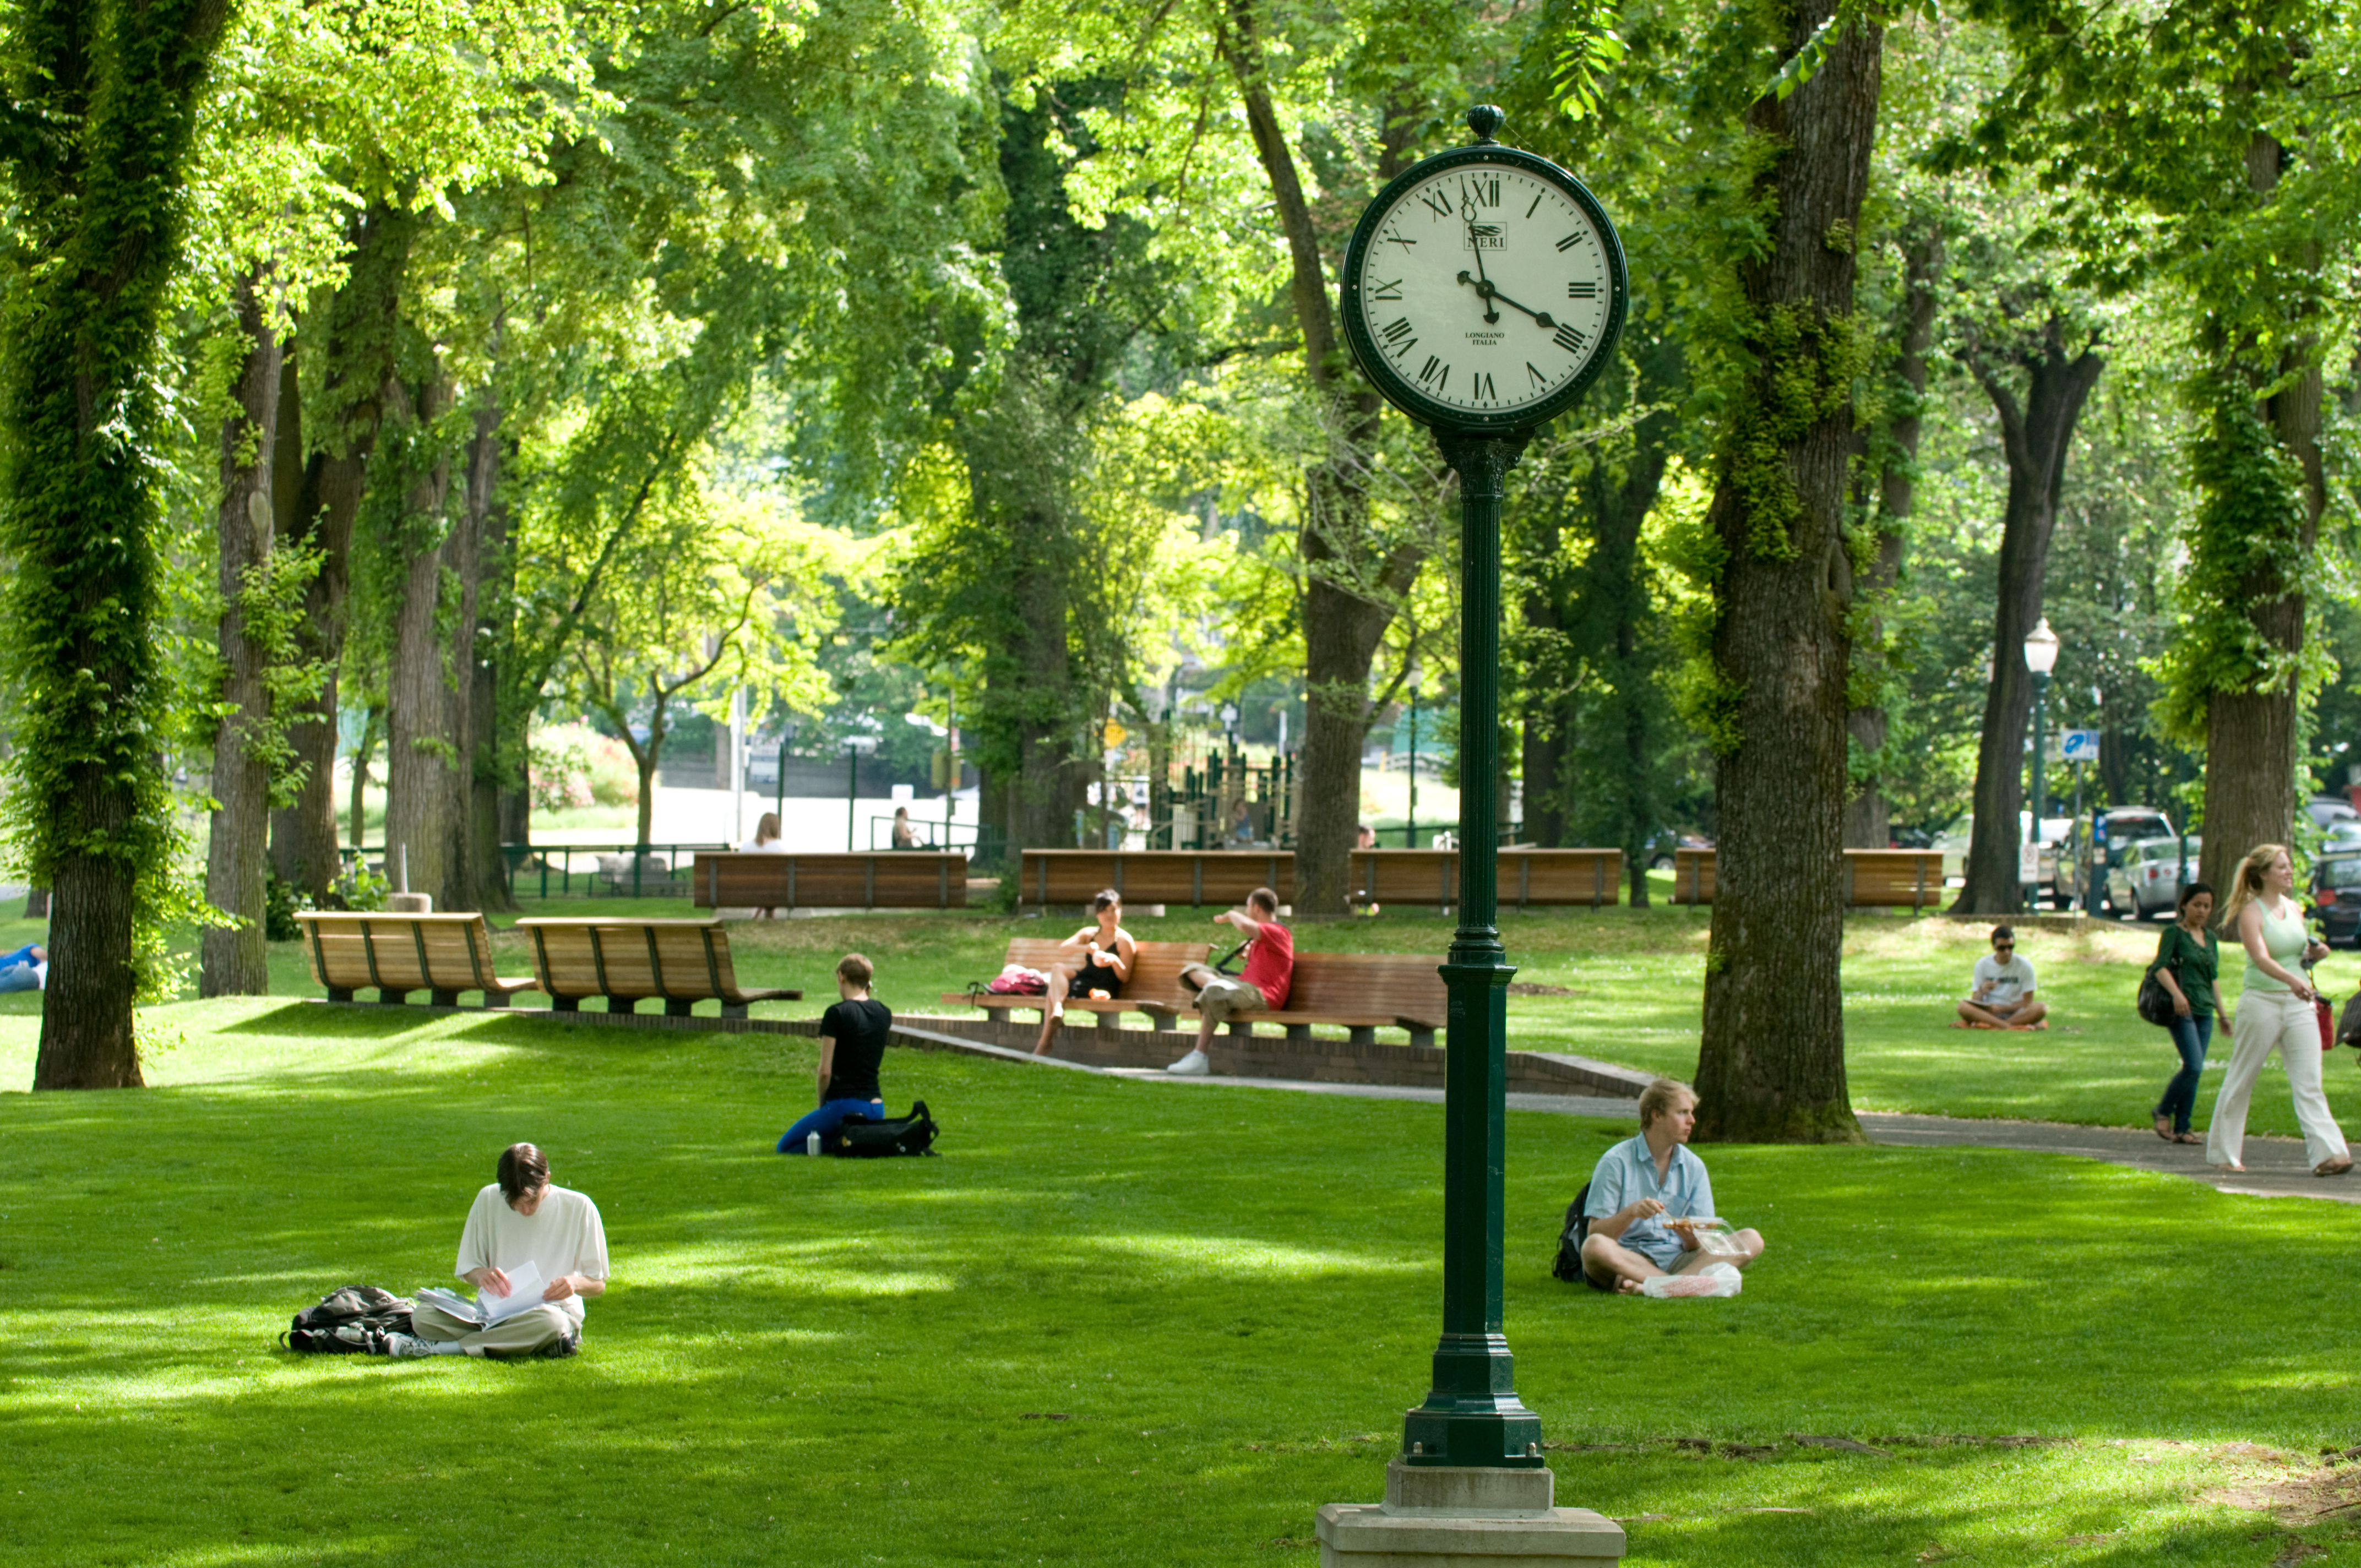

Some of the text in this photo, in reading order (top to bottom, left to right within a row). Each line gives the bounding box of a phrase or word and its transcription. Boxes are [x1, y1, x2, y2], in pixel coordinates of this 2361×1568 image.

[1472, 179, 1500, 207] XII
[1422, 190, 1453, 223] XI
[1526, 194, 1542, 219] I
[1387, 228, 1417, 254] X
[1467, 237, 1504, 247] NERI
[1555, 231, 1583, 253] II
[1568, 282, 1596, 299] III
[1526, 361, 1547, 389] V
